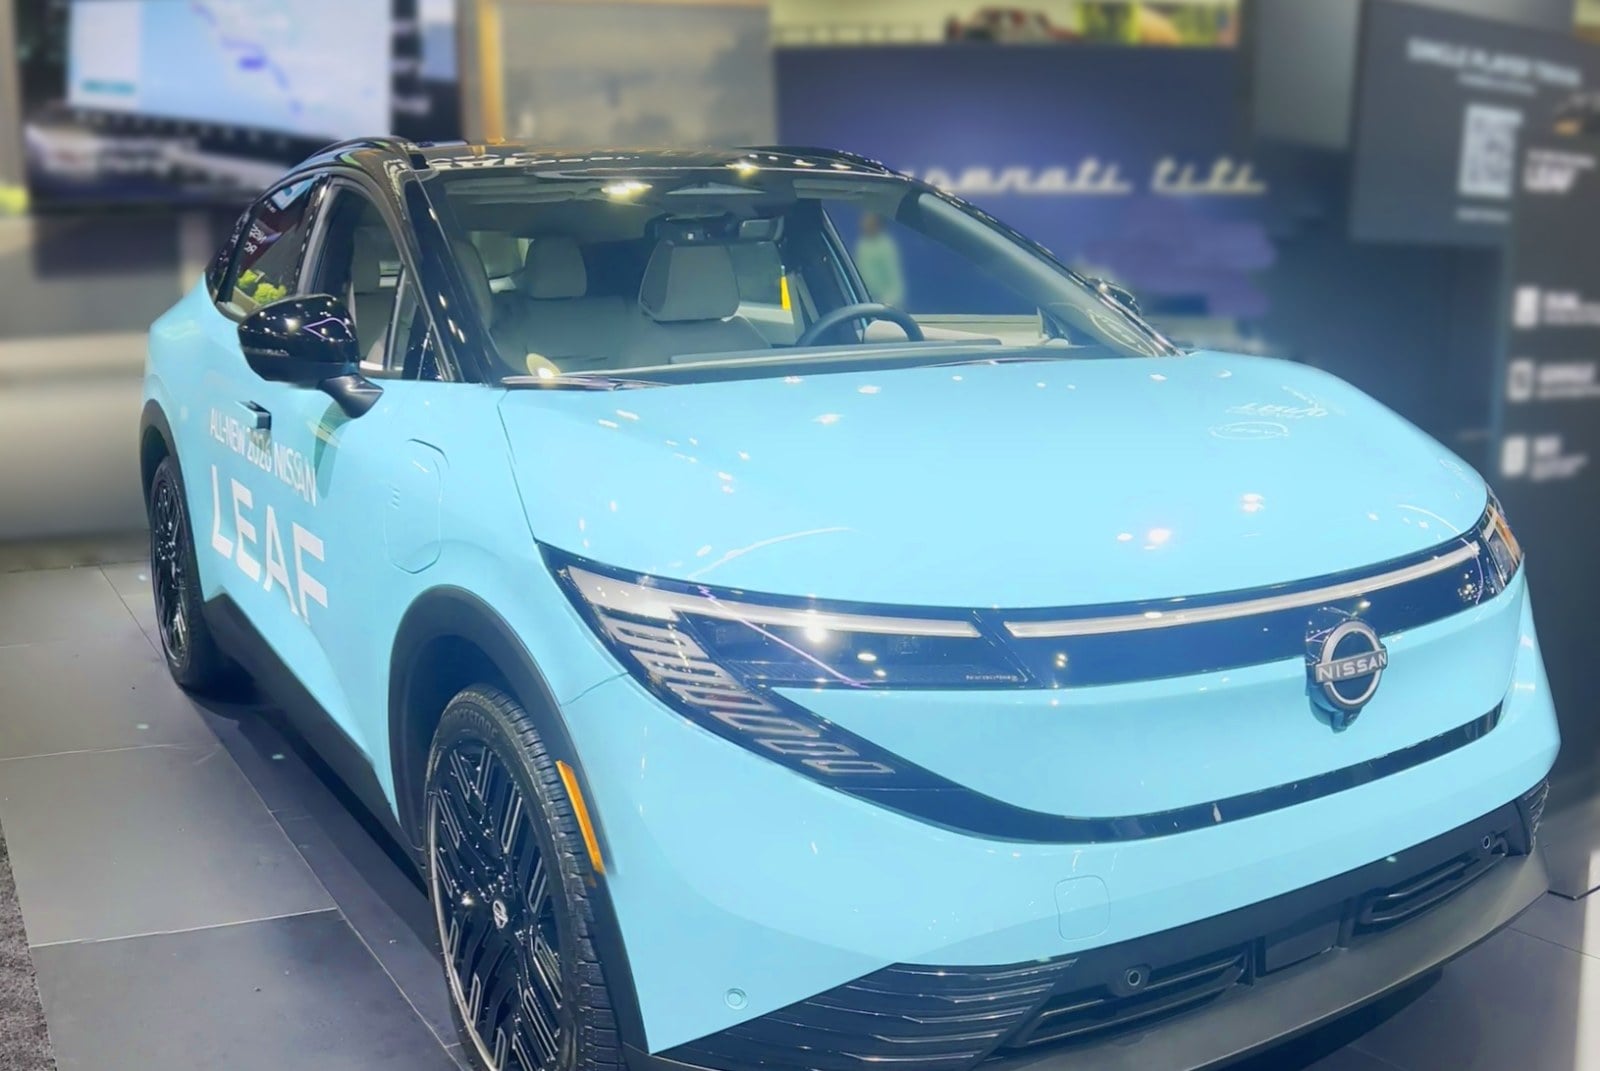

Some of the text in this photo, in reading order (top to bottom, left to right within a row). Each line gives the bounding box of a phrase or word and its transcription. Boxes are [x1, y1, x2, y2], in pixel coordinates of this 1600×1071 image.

[210, 407, 246, 457] ALL-NEW
[273, 441, 317, 507] NISSAN
[211, 463, 328, 626] LEAF
[1319, 651, 1388, 682] NISSAN
